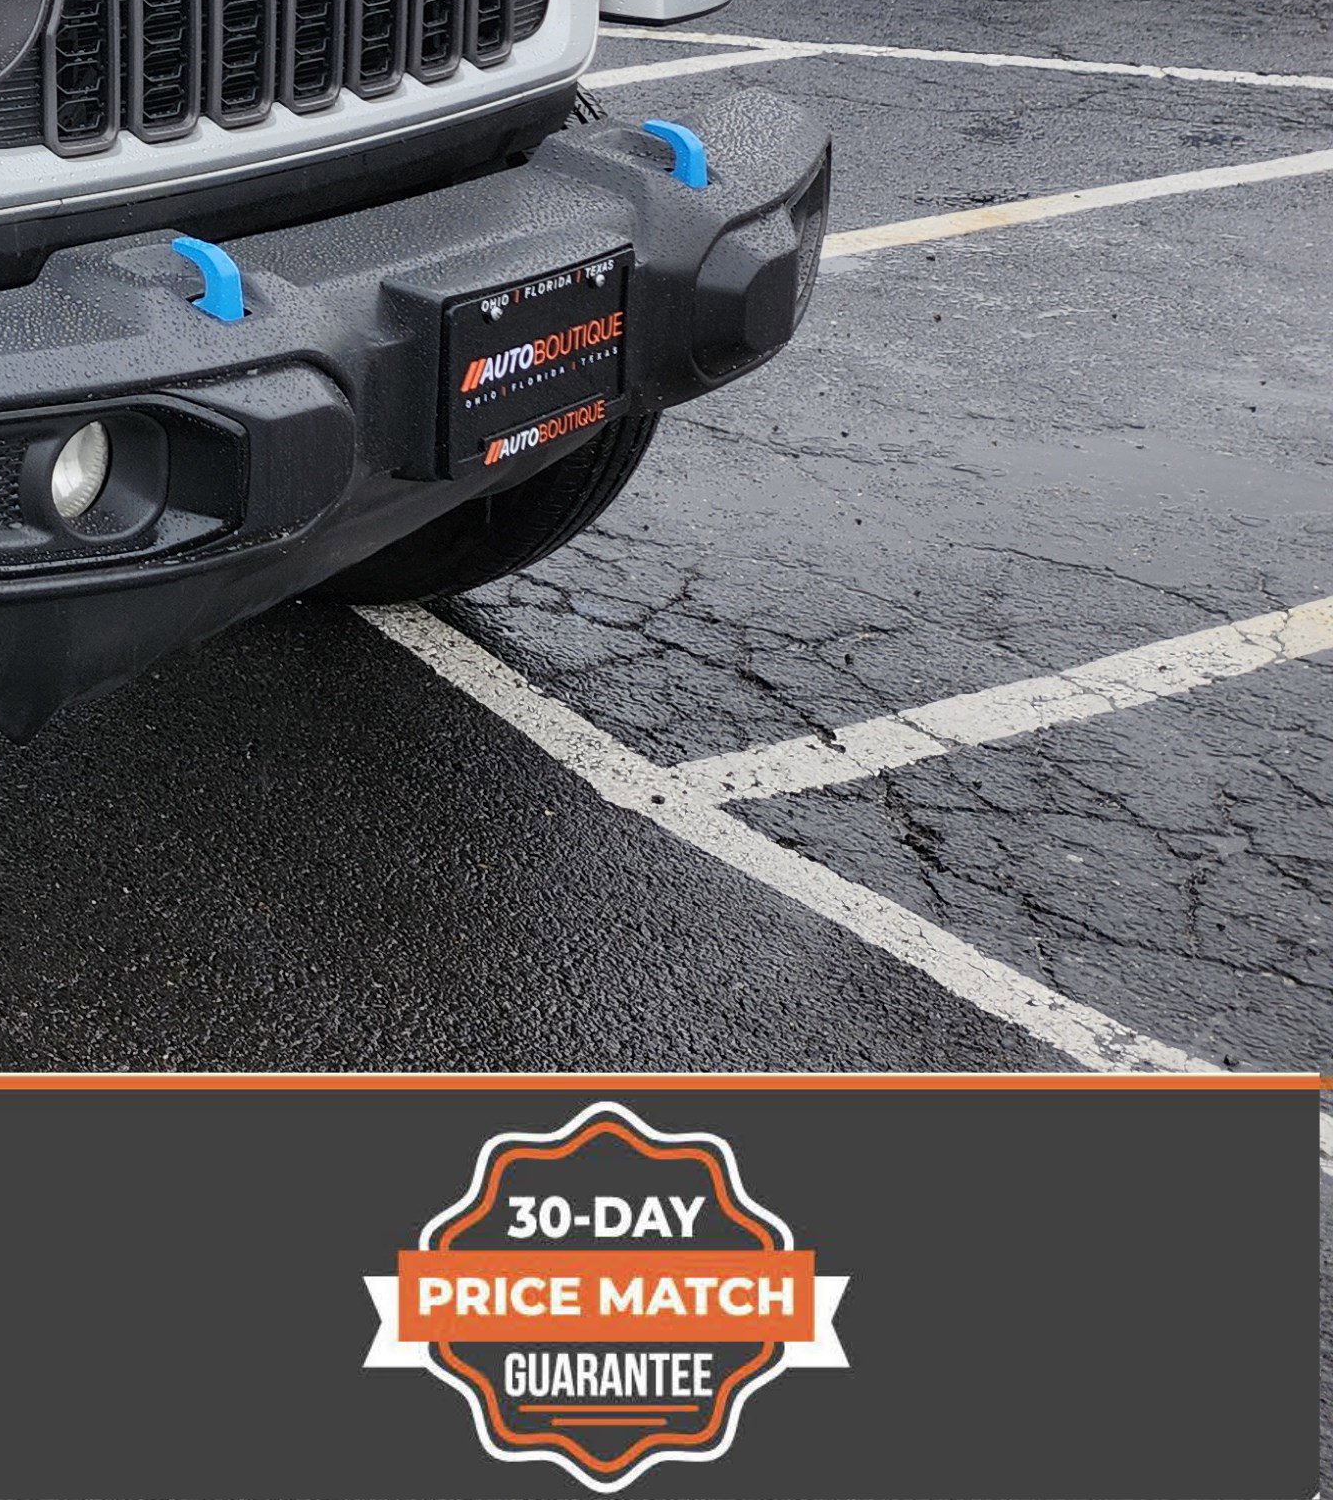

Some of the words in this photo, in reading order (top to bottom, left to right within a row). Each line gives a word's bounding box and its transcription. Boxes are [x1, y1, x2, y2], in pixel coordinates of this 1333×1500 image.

[481, 294, 510, 313] OHIO
[524, 274, 572, 299] FLORIDA
[585, 259, 615, 280] TEXAS
[465, 390, 498, 410] OHIO
[511, 366, 566, 393] FLORIDA
[581, 346, 619, 367] TEXAS
